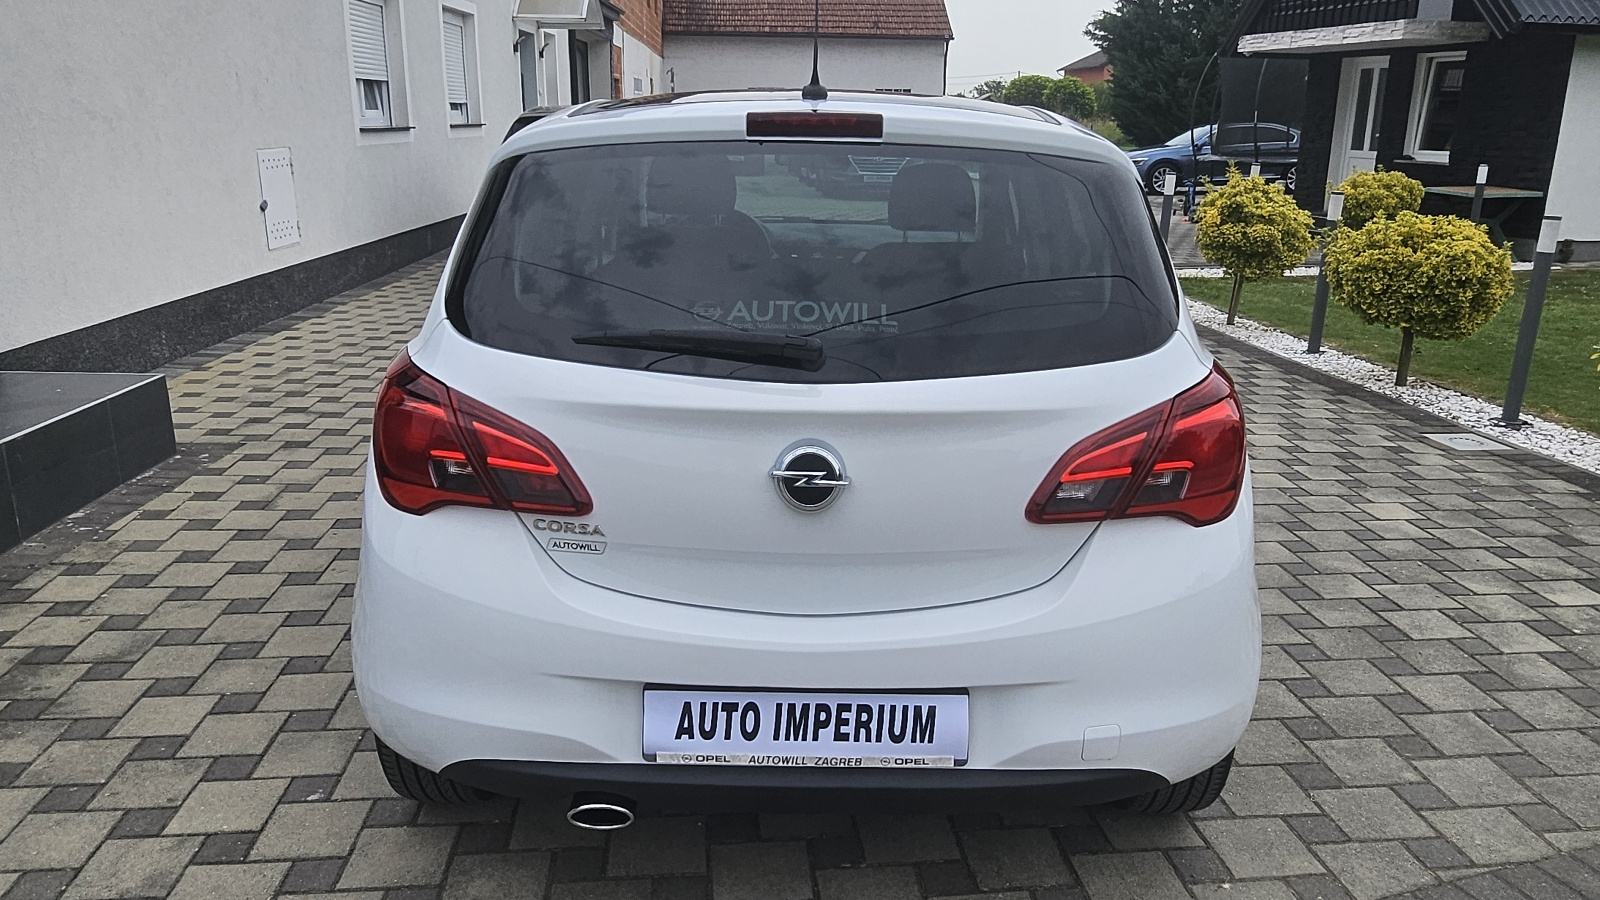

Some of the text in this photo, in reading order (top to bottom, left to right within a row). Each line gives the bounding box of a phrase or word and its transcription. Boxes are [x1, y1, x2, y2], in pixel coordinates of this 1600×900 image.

[727, 300, 898, 326] AUTOWILL
[533, 518, 606, 537] CORSA
[552, 541, 600, 551] AUTOWILL
[674, 700, 937, 744] AUTO IMPERIUM
[695, 754, 930, 767] OPEL AUTOWILL ZAGREB OPEL
